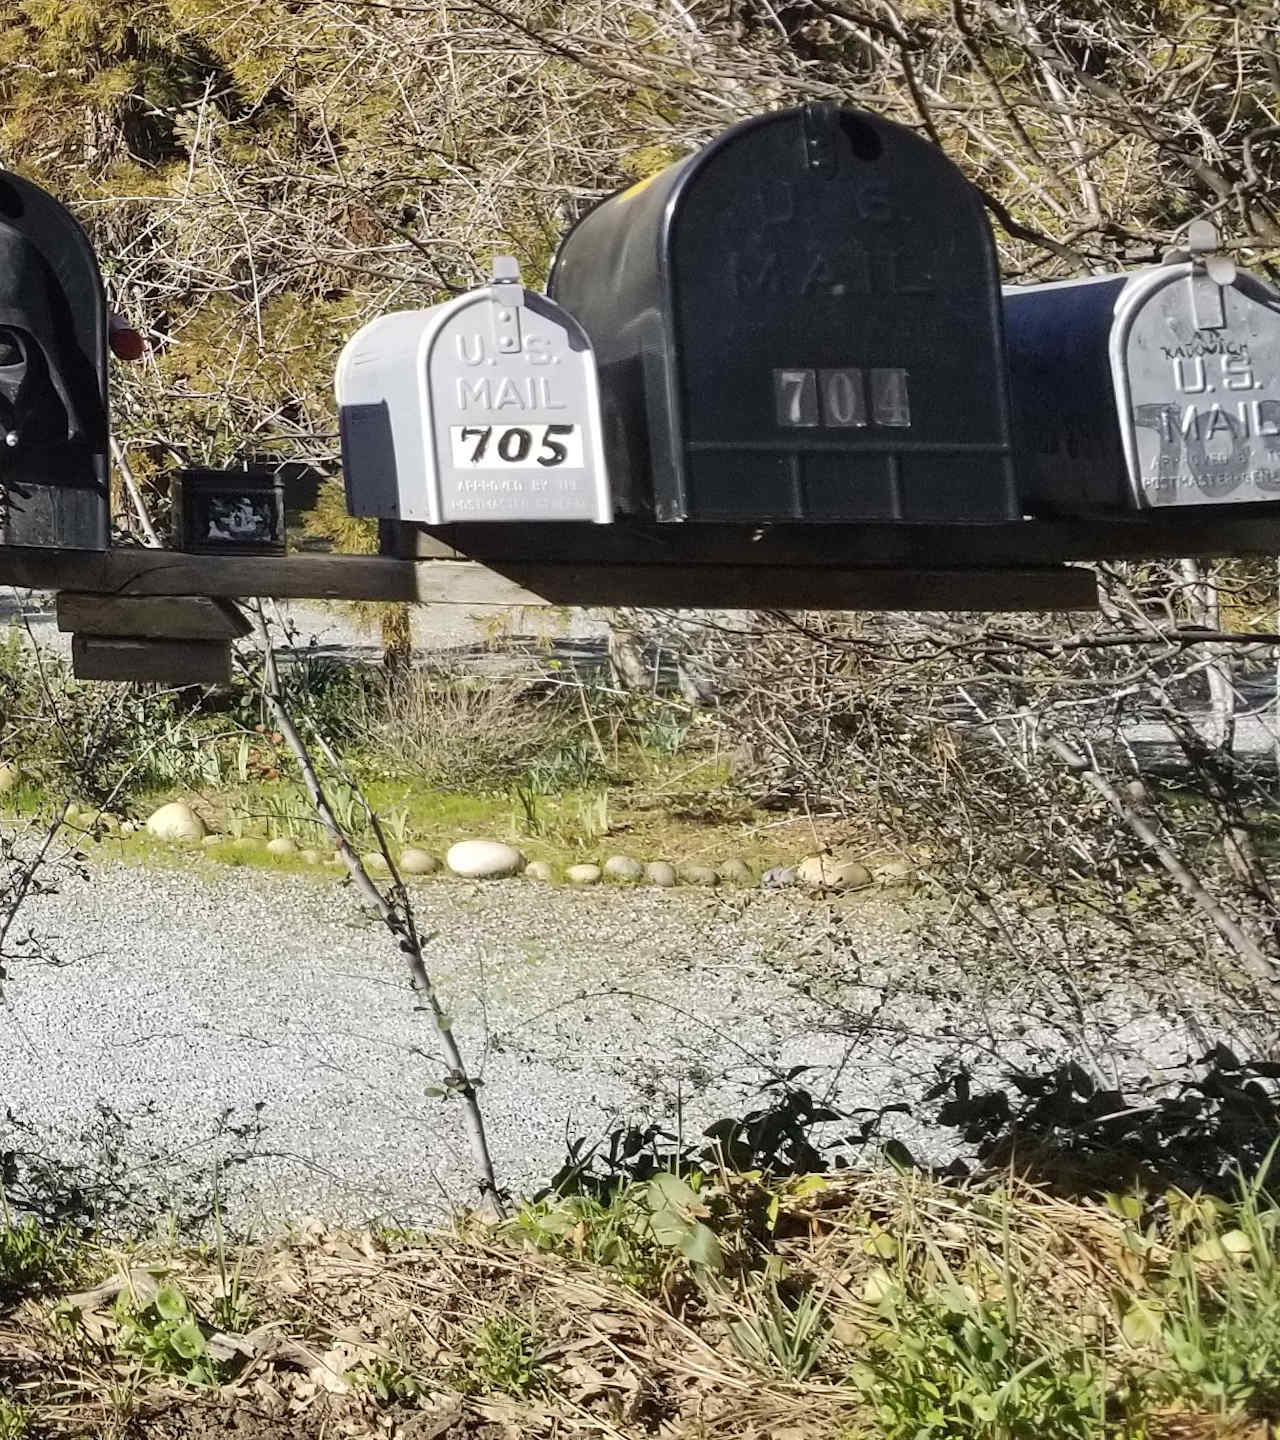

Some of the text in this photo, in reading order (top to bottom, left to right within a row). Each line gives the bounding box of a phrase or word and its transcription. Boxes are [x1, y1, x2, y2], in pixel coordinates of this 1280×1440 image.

[455, 376, 568, 411] MAIL
[1159, 400, 1279, 443] MAIL
[461, 424, 575, 467] 705
